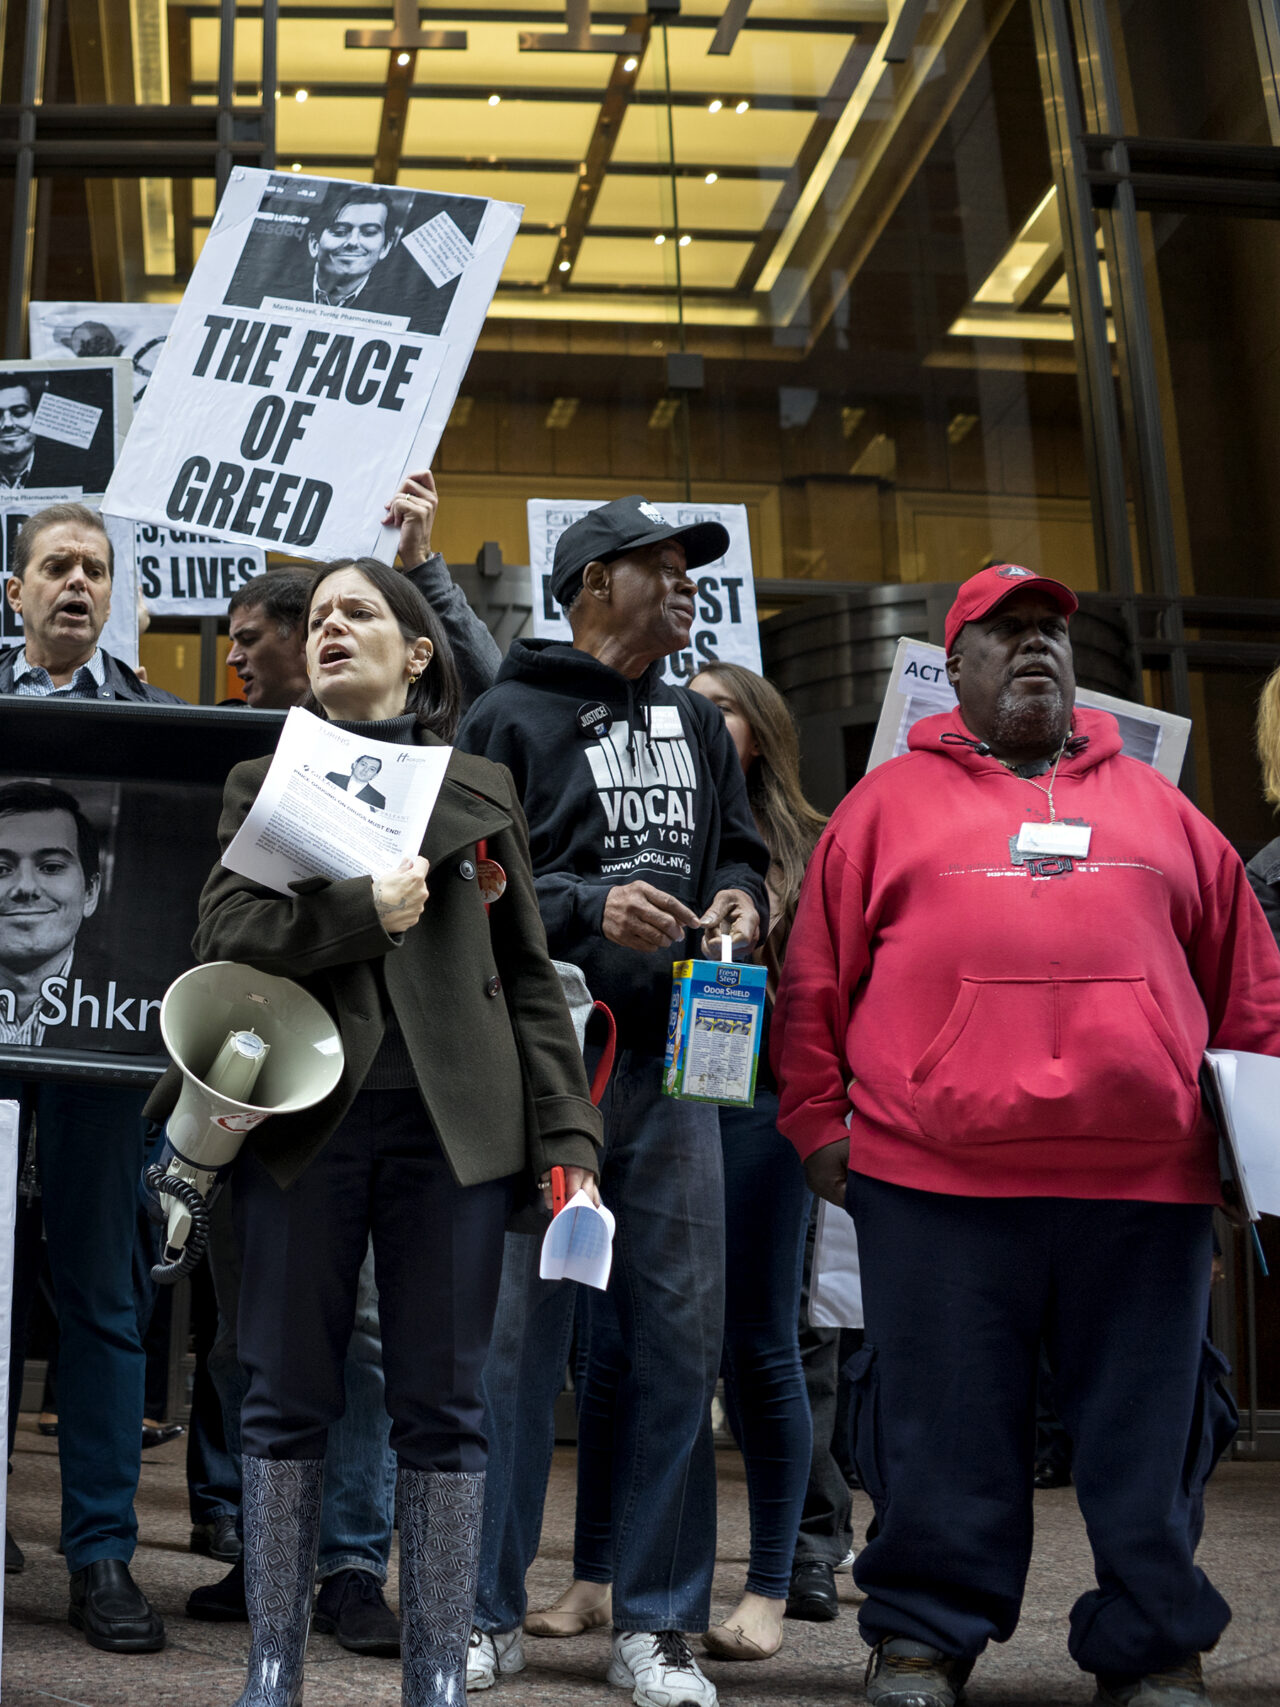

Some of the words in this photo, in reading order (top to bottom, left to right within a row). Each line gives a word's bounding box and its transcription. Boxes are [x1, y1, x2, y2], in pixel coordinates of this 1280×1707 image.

[191, 314, 292, 388] THE
[285, 329, 423, 412] FACE
[239, 395, 317, 465] OF
[165, 455, 334, 547] GREED
[170, 556, 257, 599] LIVES
[904, 661, 945, 683] ACT
[598, 788, 696, 832] VOCAL
[604, 829, 650, 849] NEW
[658, 828, 694, 849] YOR
[718, 968, 739, 978] Fresh
[719, 975, 738, 985] Step
[39, 976, 163, 1032] Shkr
